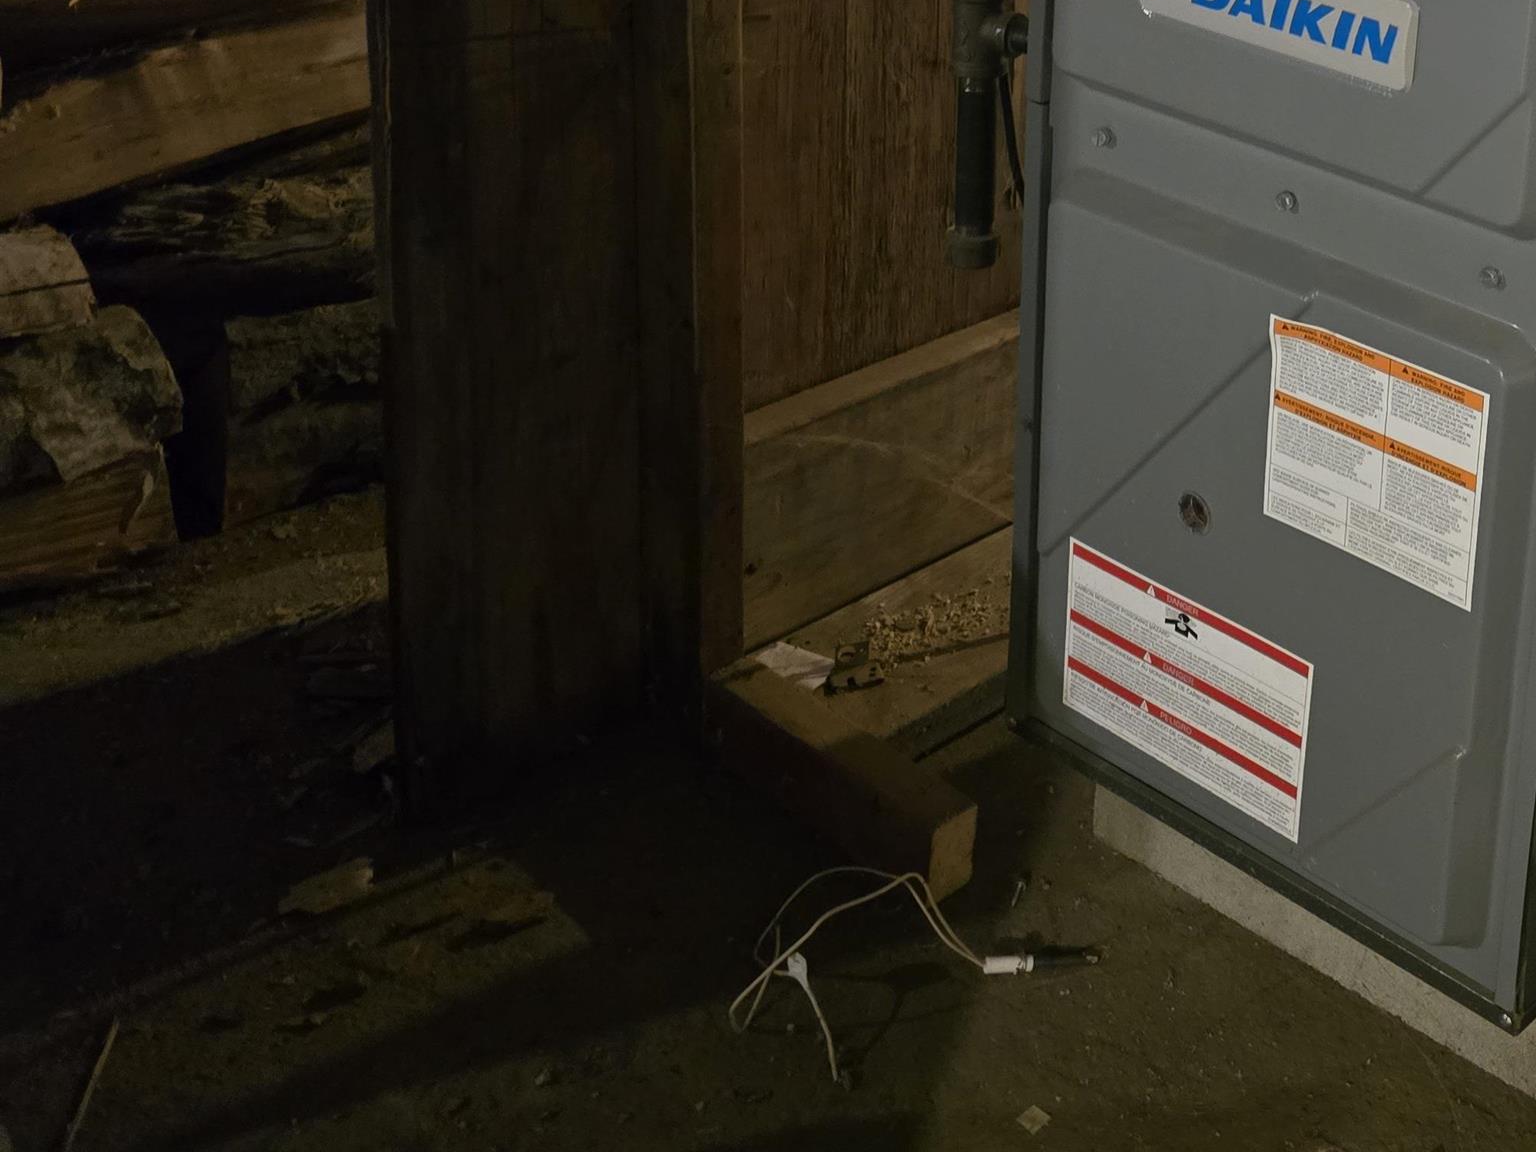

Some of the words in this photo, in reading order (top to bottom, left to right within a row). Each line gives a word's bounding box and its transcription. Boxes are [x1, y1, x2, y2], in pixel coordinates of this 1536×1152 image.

[1166, 594, 1199, 617] DANGER
[1162, 663, 1194, 686] DANGER
[1160, 712, 1193, 736] PELIGRO
